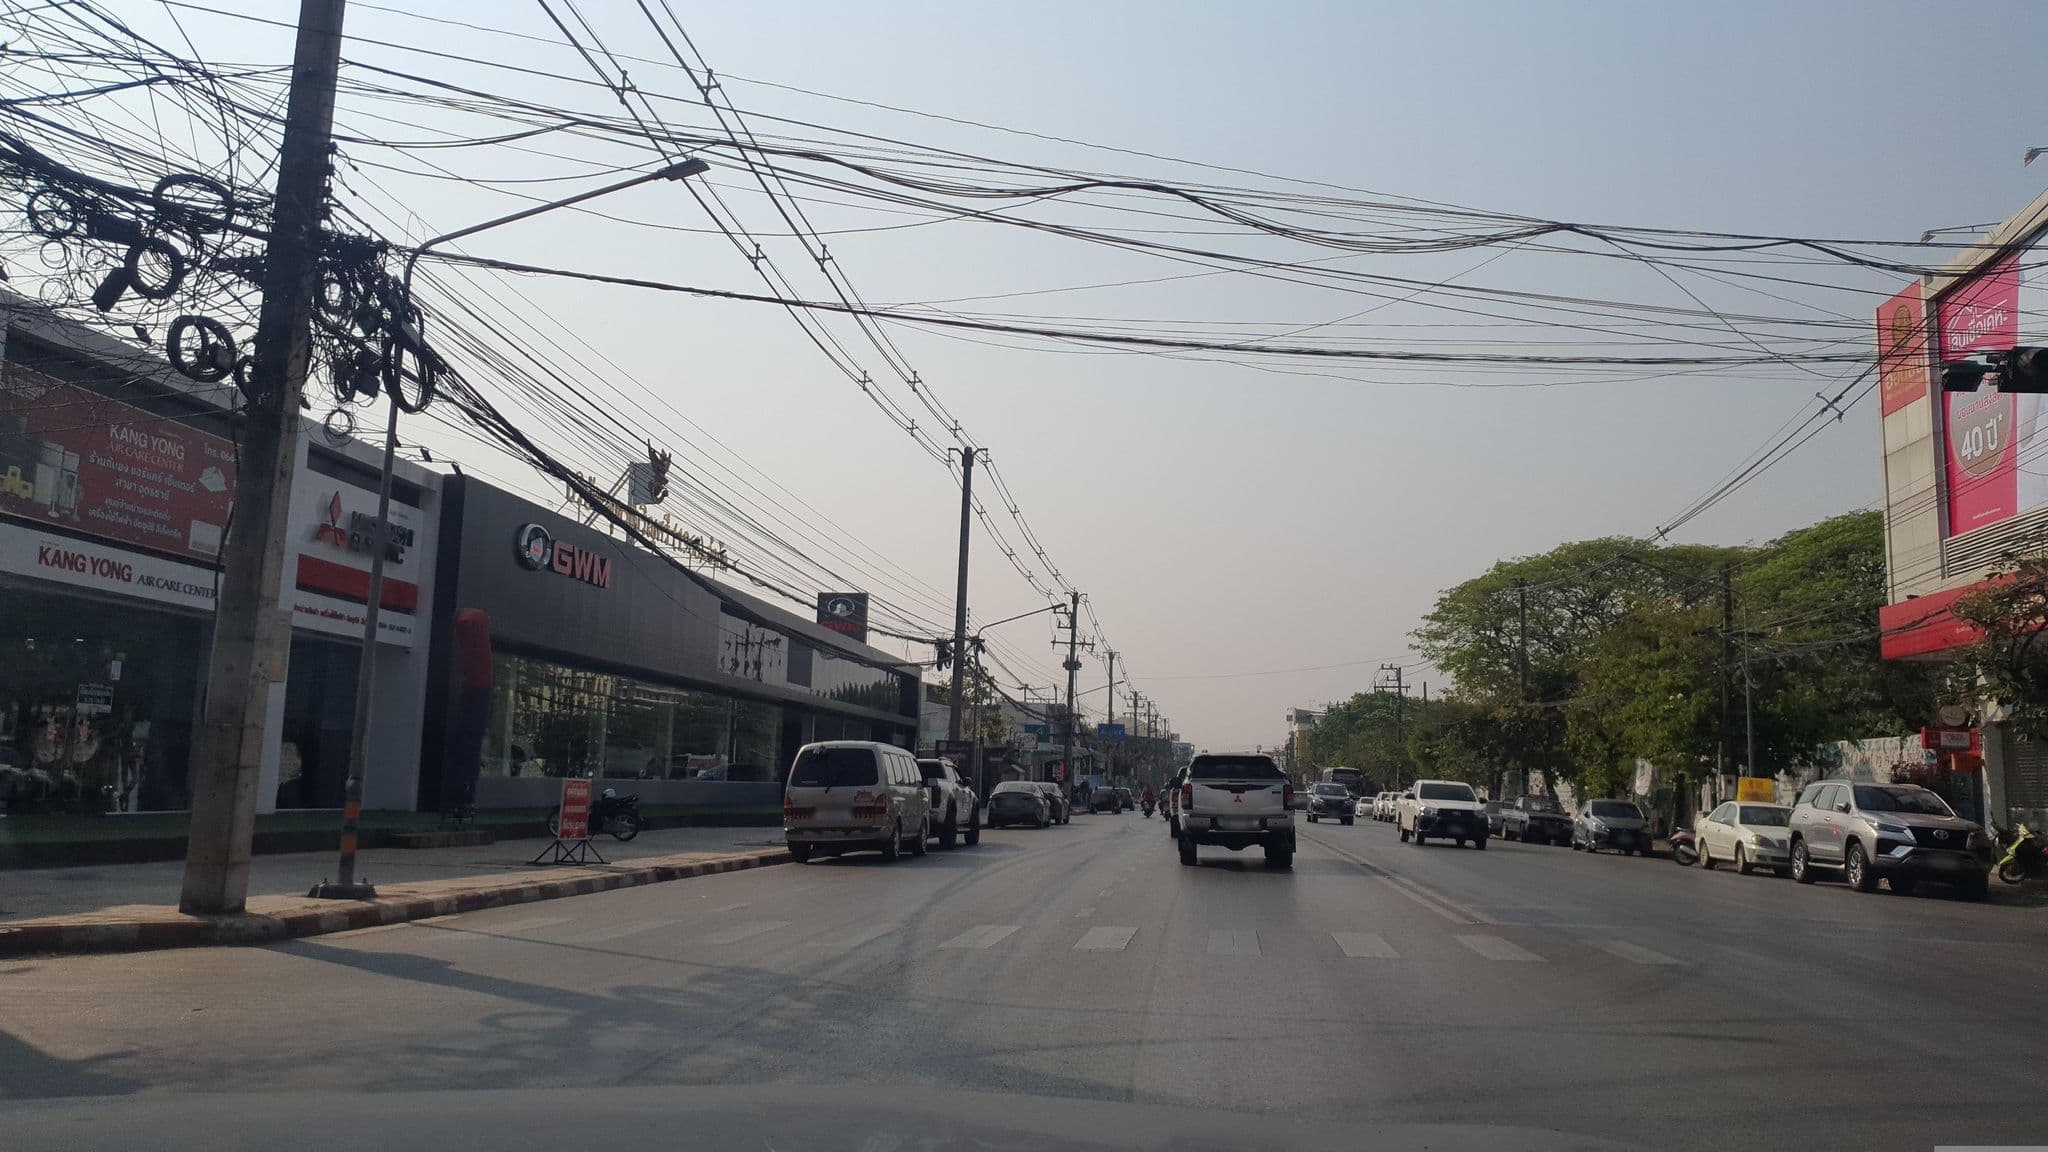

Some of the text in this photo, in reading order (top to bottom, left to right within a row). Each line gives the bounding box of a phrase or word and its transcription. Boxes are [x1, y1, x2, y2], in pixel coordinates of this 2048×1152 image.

[110, 424, 149, 448] KANG
[150, 434, 186, 461] YONG
[1961, 426, 1983, 461] 40
[38, 545, 88, 574] KANG
[90, 556, 133, 583] YONG
[137, 573, 156, 588] AIR
[156, 577, 183, 593] CARE
[552, 539, 613, 589] GWM
